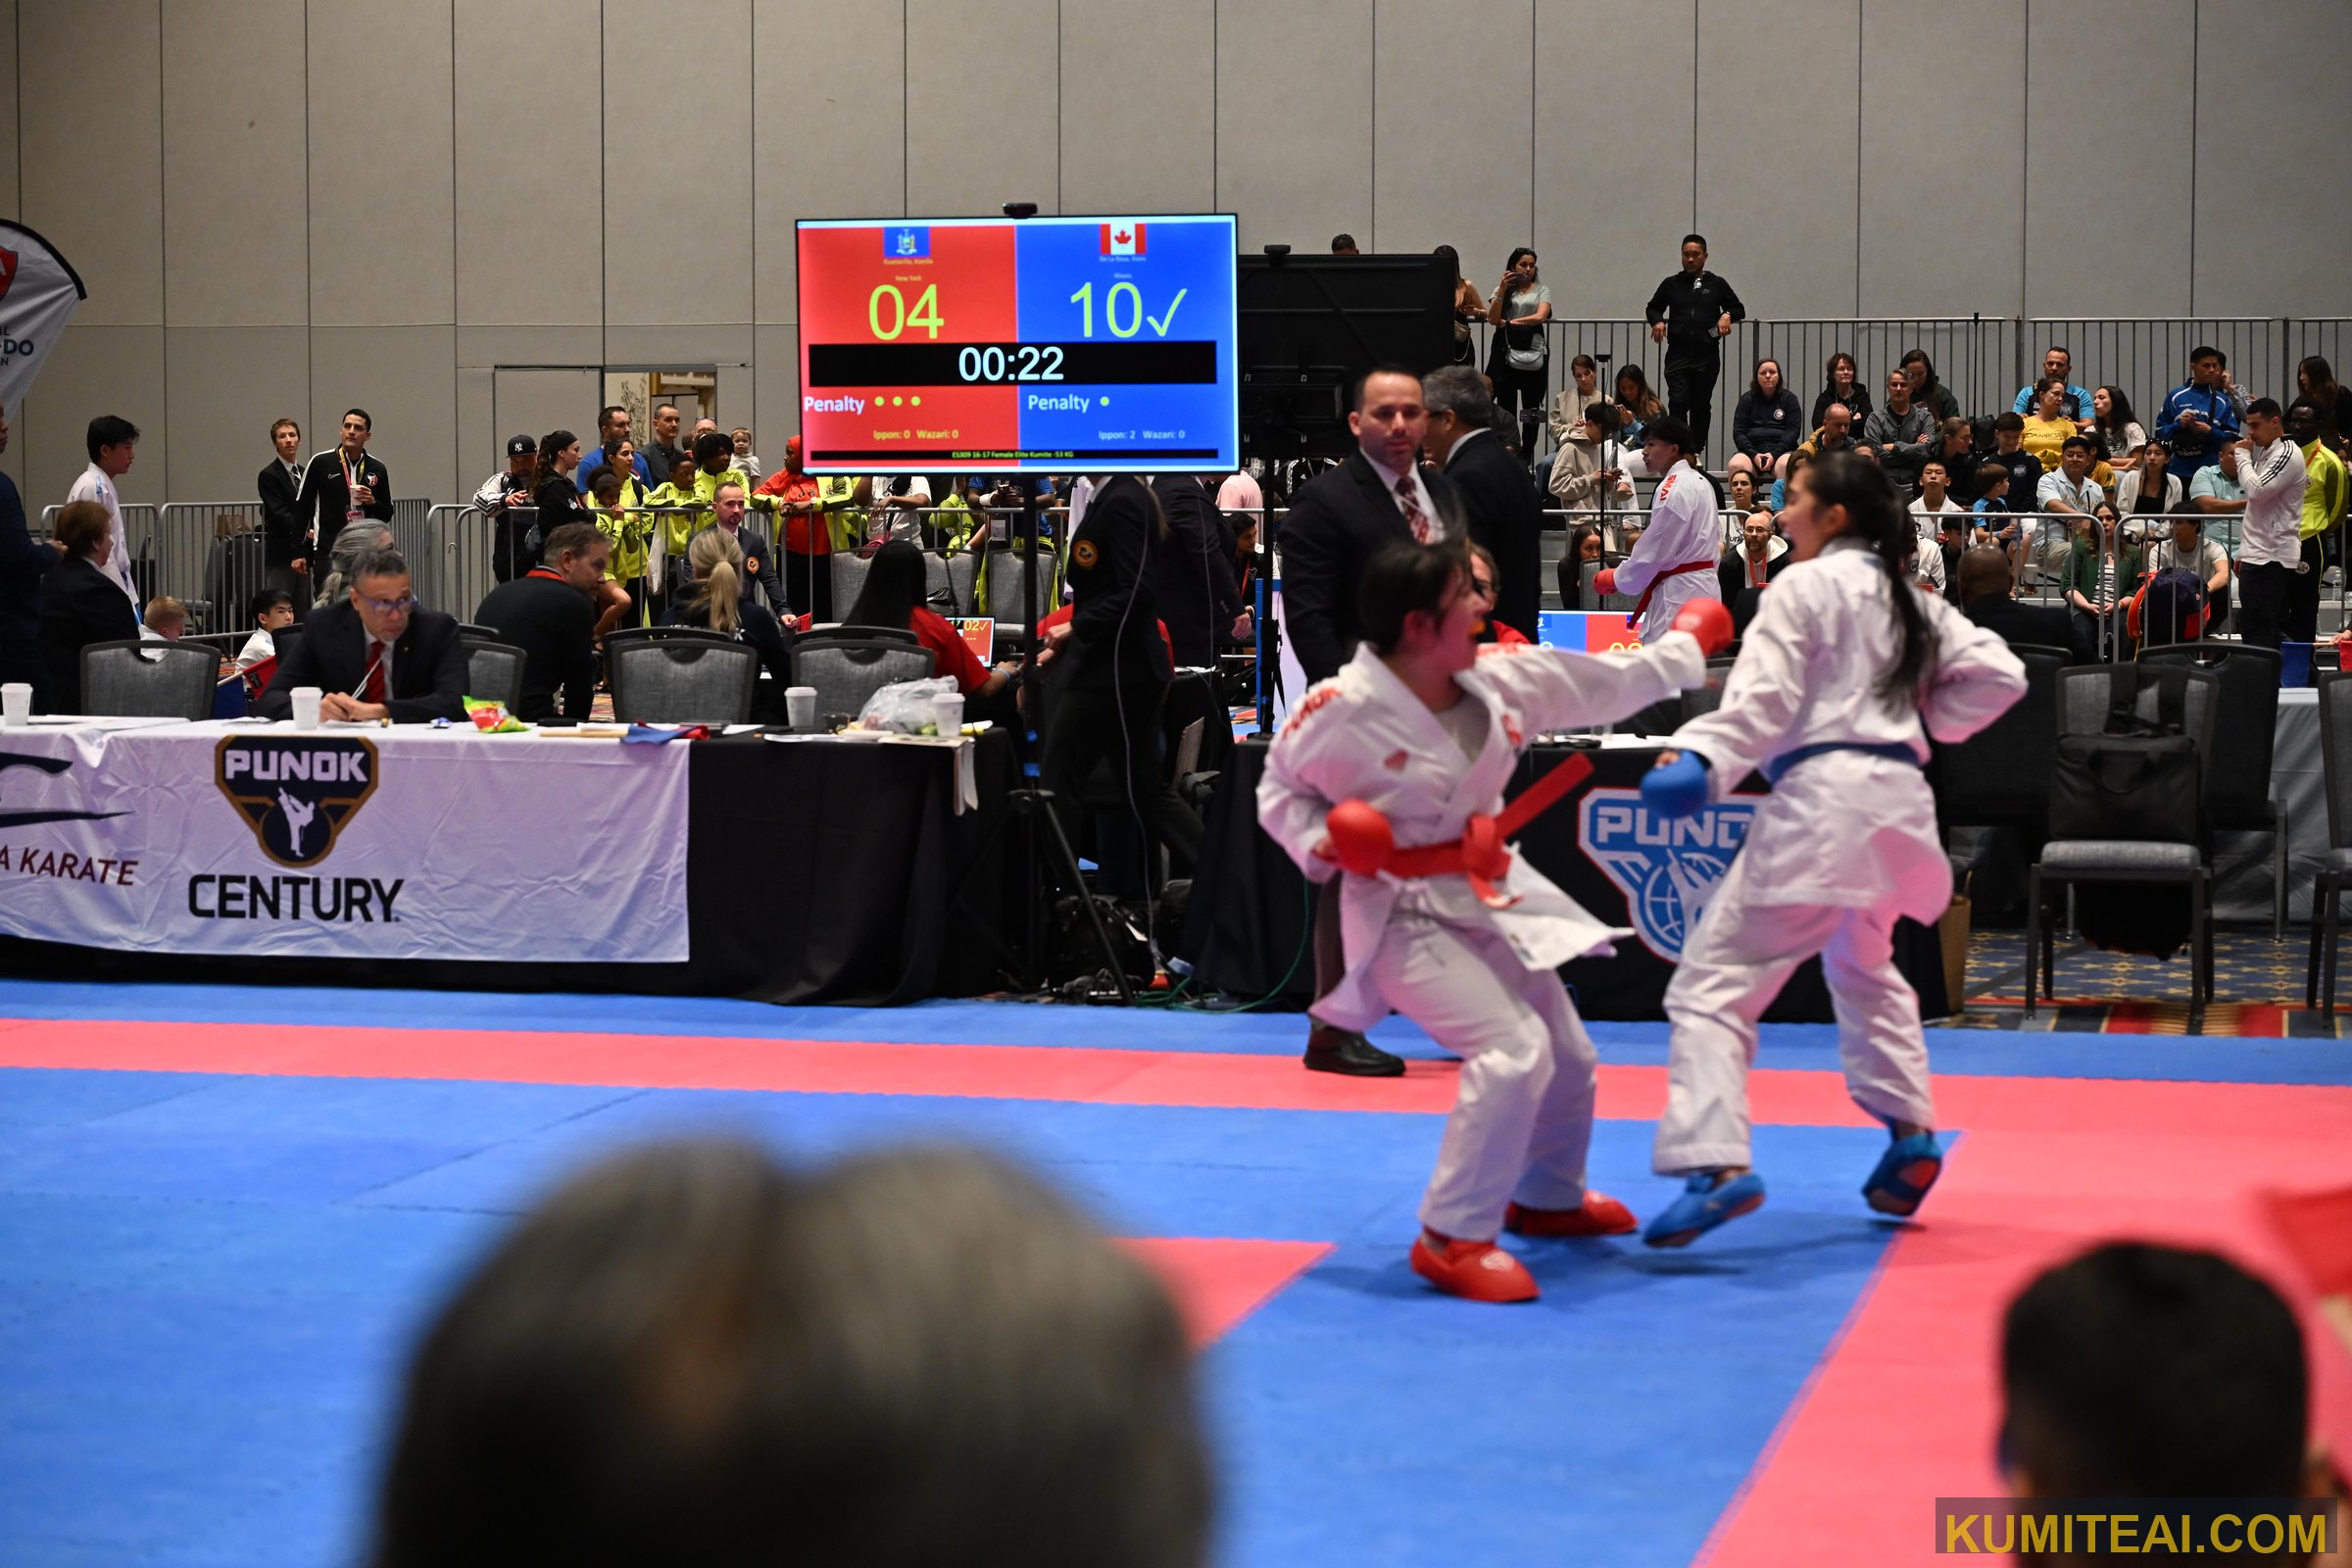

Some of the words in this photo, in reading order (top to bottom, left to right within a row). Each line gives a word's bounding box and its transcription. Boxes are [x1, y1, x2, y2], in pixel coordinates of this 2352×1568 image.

[869, 284, 944, 340] 04
[1070, 281, 1143, 337] 10
[0, 339, 34, 356] DO
[958, 346, 1064, 381] 00:22
[804, 395, 865, 415] Penalty
[1028, 394, 1090, 414] Penalty
[873, 430, 902, 440] Ippon:
[904, 430, 910, 439] 0
[916, 430, 950, 439] Wazari:
[952, 430, 958, 439] 0
[1099, 430, 1127, 440] Ippon:
[1130, 430, 1136, 439] 2
[1143, 430, 1176, 439] Wazari:
[1178, 430, 1185, 439] 0
[1660, 474, 1677, 502] SMAI
[964, 620, 980, 631] 02
[225, 749, 368, 782] PUNOK
[1596, 806, 1753, 850] PUNO
[20, 848, 139, 886] KARATE
[188, 874, 405, 922] CENTURY
